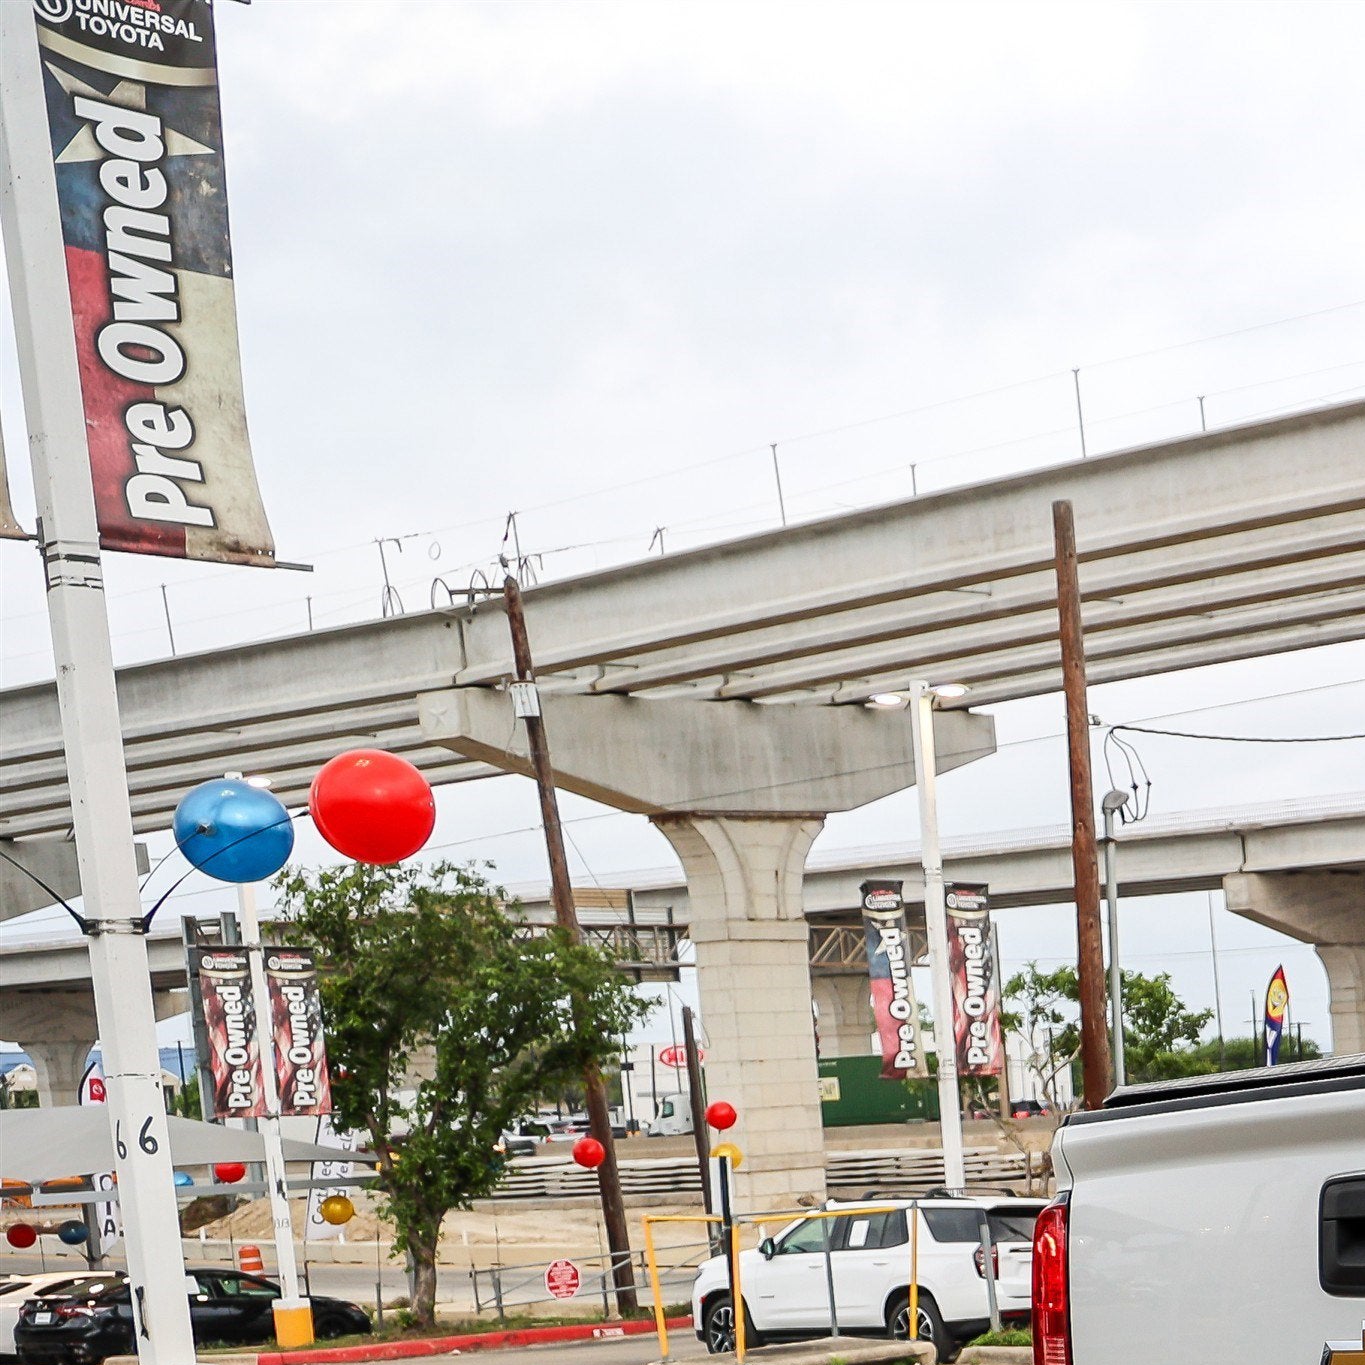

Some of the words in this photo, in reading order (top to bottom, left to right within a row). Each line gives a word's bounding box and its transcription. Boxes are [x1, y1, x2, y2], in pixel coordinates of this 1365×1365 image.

[75, 0, 203, 42] UNIVERSAL
[75, 12, 165, 51] TOYOTA
[74, 96, 184, 386] Owned
[126, 404, 215, 527] Pre
[880, 928, 911, 1020] Owned
[959, 927, 986, 1017] Owned
[216, 986, 249, 1066] Owned
[281, 986, 312, 1065] Owned
[894, 1024, 916, 1068] Pre
[968, 1021, 989, 1064] Pre
[228, 1069, 252, 1108] Pre
[293, 1068, 316, 1106] Pre
[116, 1119, 128, 1160] 6
[139, 1116, 158, 1155] 6
